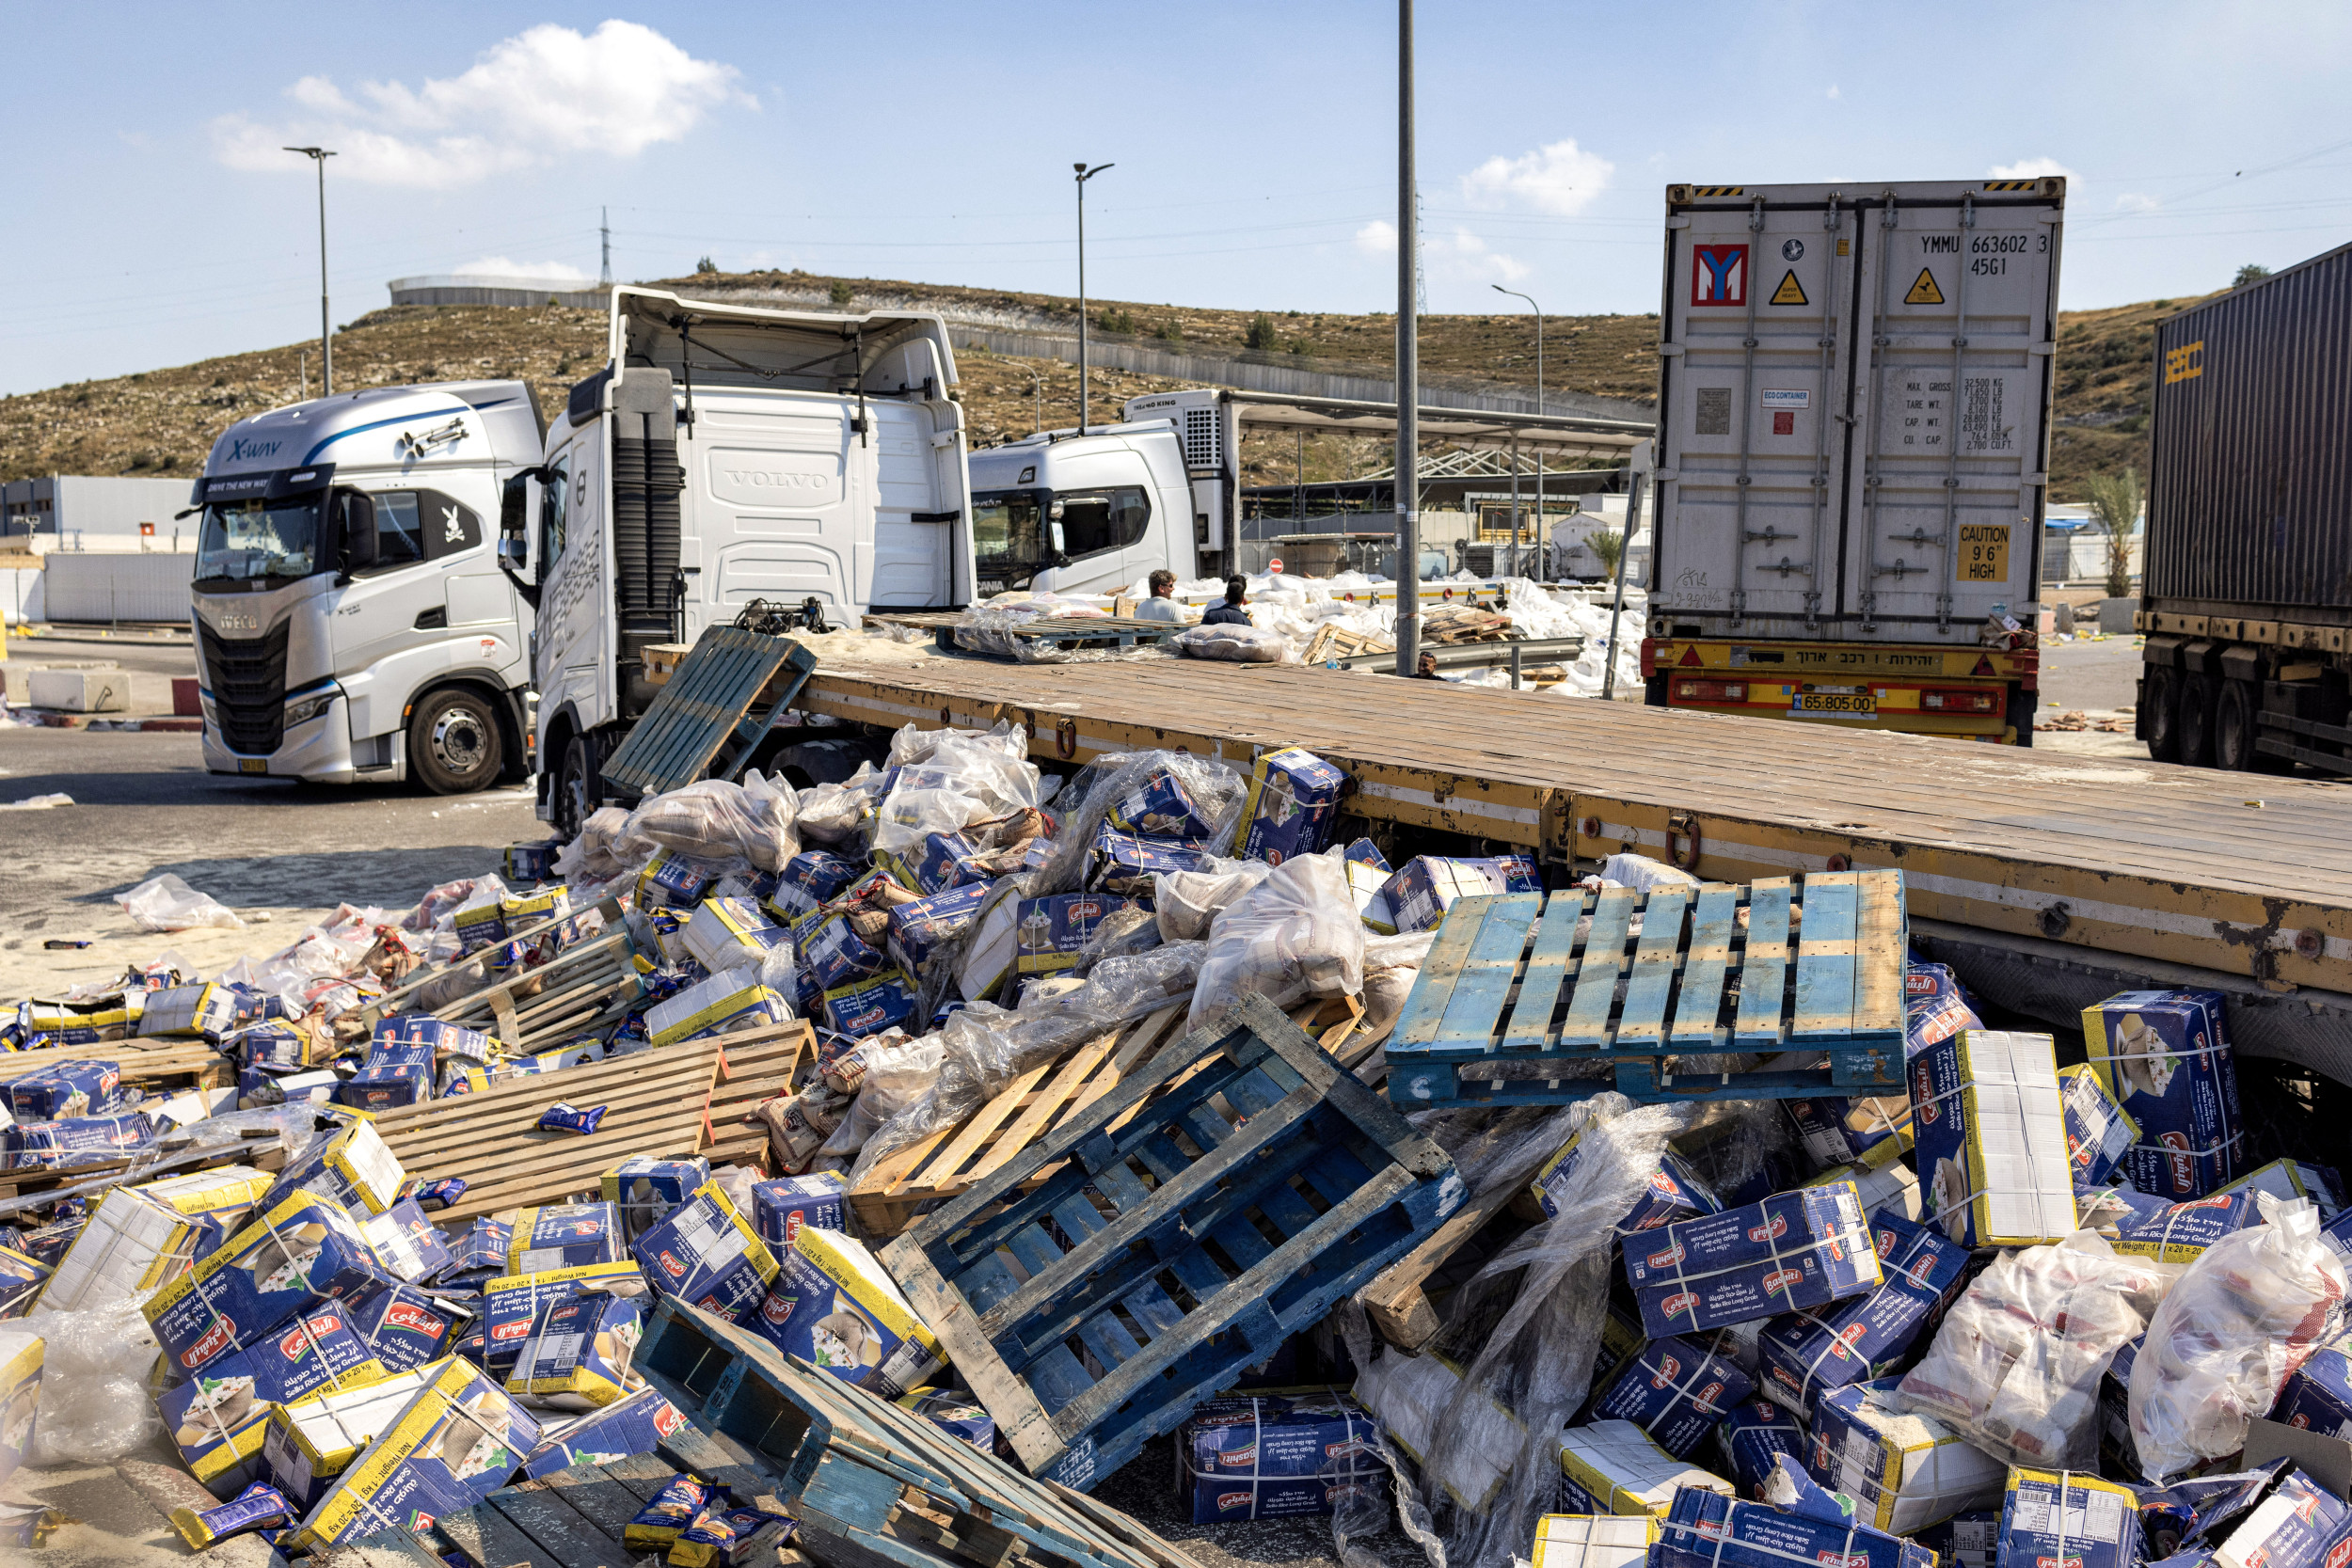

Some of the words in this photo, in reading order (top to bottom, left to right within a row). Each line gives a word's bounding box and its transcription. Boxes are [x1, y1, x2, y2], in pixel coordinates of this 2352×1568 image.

[1922, 236, 1960, 253] YMMU
[1972, 235, 2027, 253] 663602
[2039, 235, 2047, 252] 3
[1971, 258, 2006, 275] 45G1
[1929, 383, 1951, 391] GROSS
[1964, 379, 1989, 388] 32.500
[1994, 378, 2003, 387] KG
[1907, 400, 1923, 409] TARE
[1992, 423, 2001, 432] LB
[723, 470, 829, 489] VOLVO
[208, 483, 225, 492] DRIVE
[226, 481, 237, 490] THE
[237, 480, 253, 489] NEW
[254, 479, 269, 488] WAY
[1962, 527, 2008, 542] CAUTION
[1969, 563, 1994, 578] HIGH
[977, 580, 1005, 591] CANIA
[220, 615, 257, 629] IVECO
[1797, 652, 1827, 663] ארוך
[1840, 654, 1865, 663] רכב
[1889, 655, 1932, 665] זהירות
[2168, 1232, 2189, 1242] Long
[2122, 1243, 2145, 1251] Weight
[225, 1251, 233, 1260] Net
[202, 1260, 223, 1275] Weight
[798, 1259, 809, 1273] Long
[550, 1273, 574, 1282] Weight
[808, 1269, 818, 1279] Rice
[826, 1266, 842, 1281] Weight
[210, 1273, 226, 1287] Sella
[818, 1276, 830, 1290] Sella
[841, 1277, 850, 1288] Net
[173, 1291, 182, 1301] 20
[491, 1291, 513, 1300] Grain
[1744, 1294, 1758, 1303] Grain
[161, 1301, 169, 1311] 20
[178, 1295, 196, 1312] Long
[152, 1307, 161, 1316] kg
[160, 1310, 179, 1327] Grain
[389, 1308, 441, 1332] البشيتي
[381, 1354, 400, 1370] Long
[284, 1370, 310, 1387] طويلة
[285, 1384, 304, 1399] Sella
[306, 1375, 320, 1387] Rice
[341, 1354, 364, 1366] Grain
[337, 1375, 346, 1385] 20
[351, 1368, 360, 1376] 20
[401, 1442, 412, 1456] Net
[378, 1455, 402, 1479] Weight
[394, 1467, 411, 1483] Sella
[361, 1485, 373, 1496] kg
[379, 1484, 396, 1502] Rice
[339, 1514, 349, 1525] 20
[328, 1525, 339, 1533] kg
[342, 1521, 365, 1544] Grain
[1745, 1524, 1762, 1533] Grain
[1764, 1528, 1779, 1539] Long
[1781, 1533, 1793, 1543] Rice
[1794, 1536, 1810, 1544] Sella
